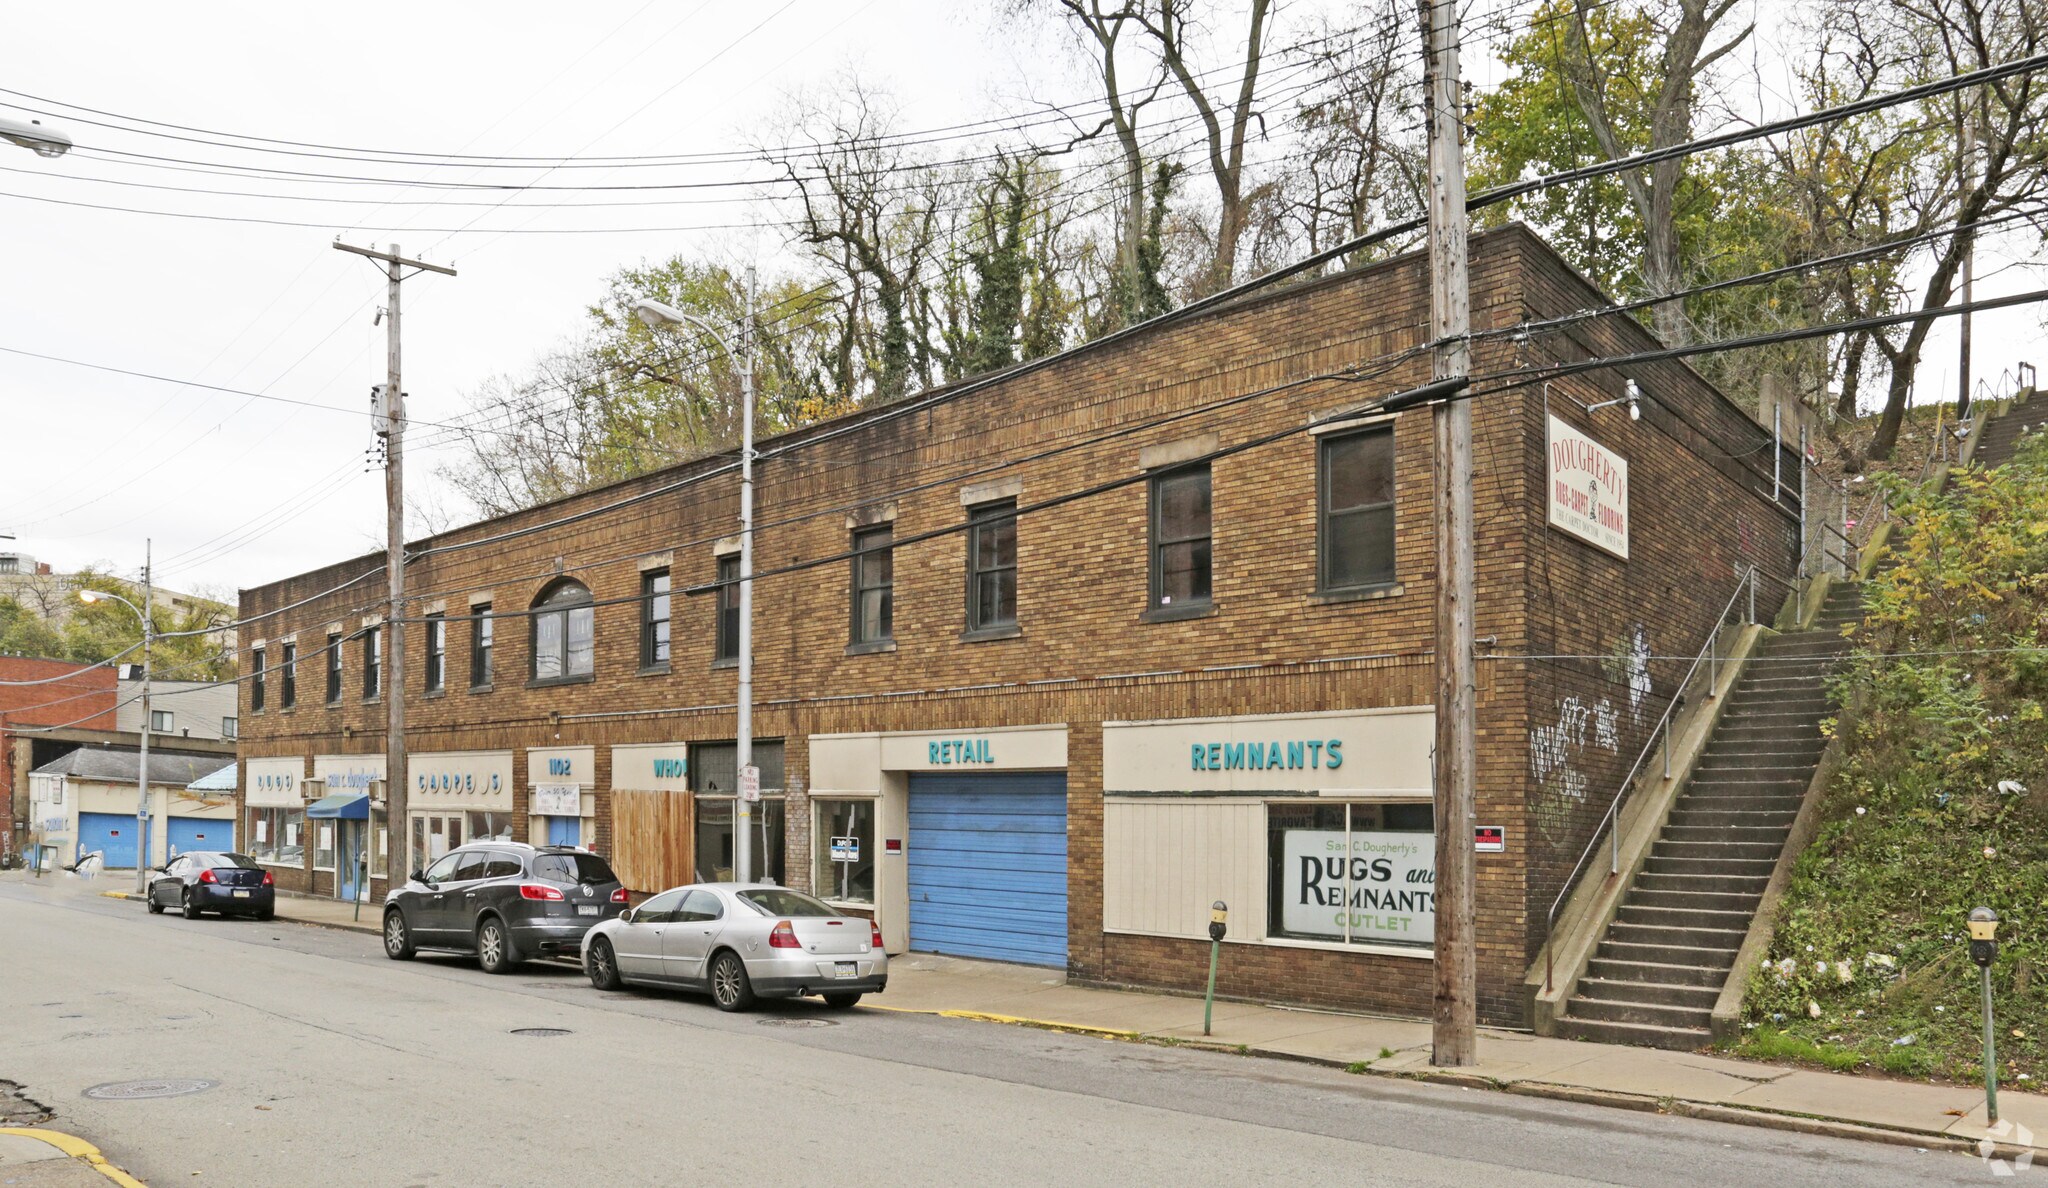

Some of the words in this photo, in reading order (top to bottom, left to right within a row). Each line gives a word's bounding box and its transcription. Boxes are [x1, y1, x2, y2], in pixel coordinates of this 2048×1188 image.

[1552, 438, 1625, 506] DOUGHERTY
[1598, 502, 1624, 535] FLOORING
[929, 739, 994, 764] RETAIL
[1191, 739, 1343, 770] REMNANTS
[549, 758, 571, 776] 1102
[1363, 841, 1418, 858] Dougherty's
[1299, 855, 1393, 906] RUGS
[1334, 913, 1412, 932] OUTLET
